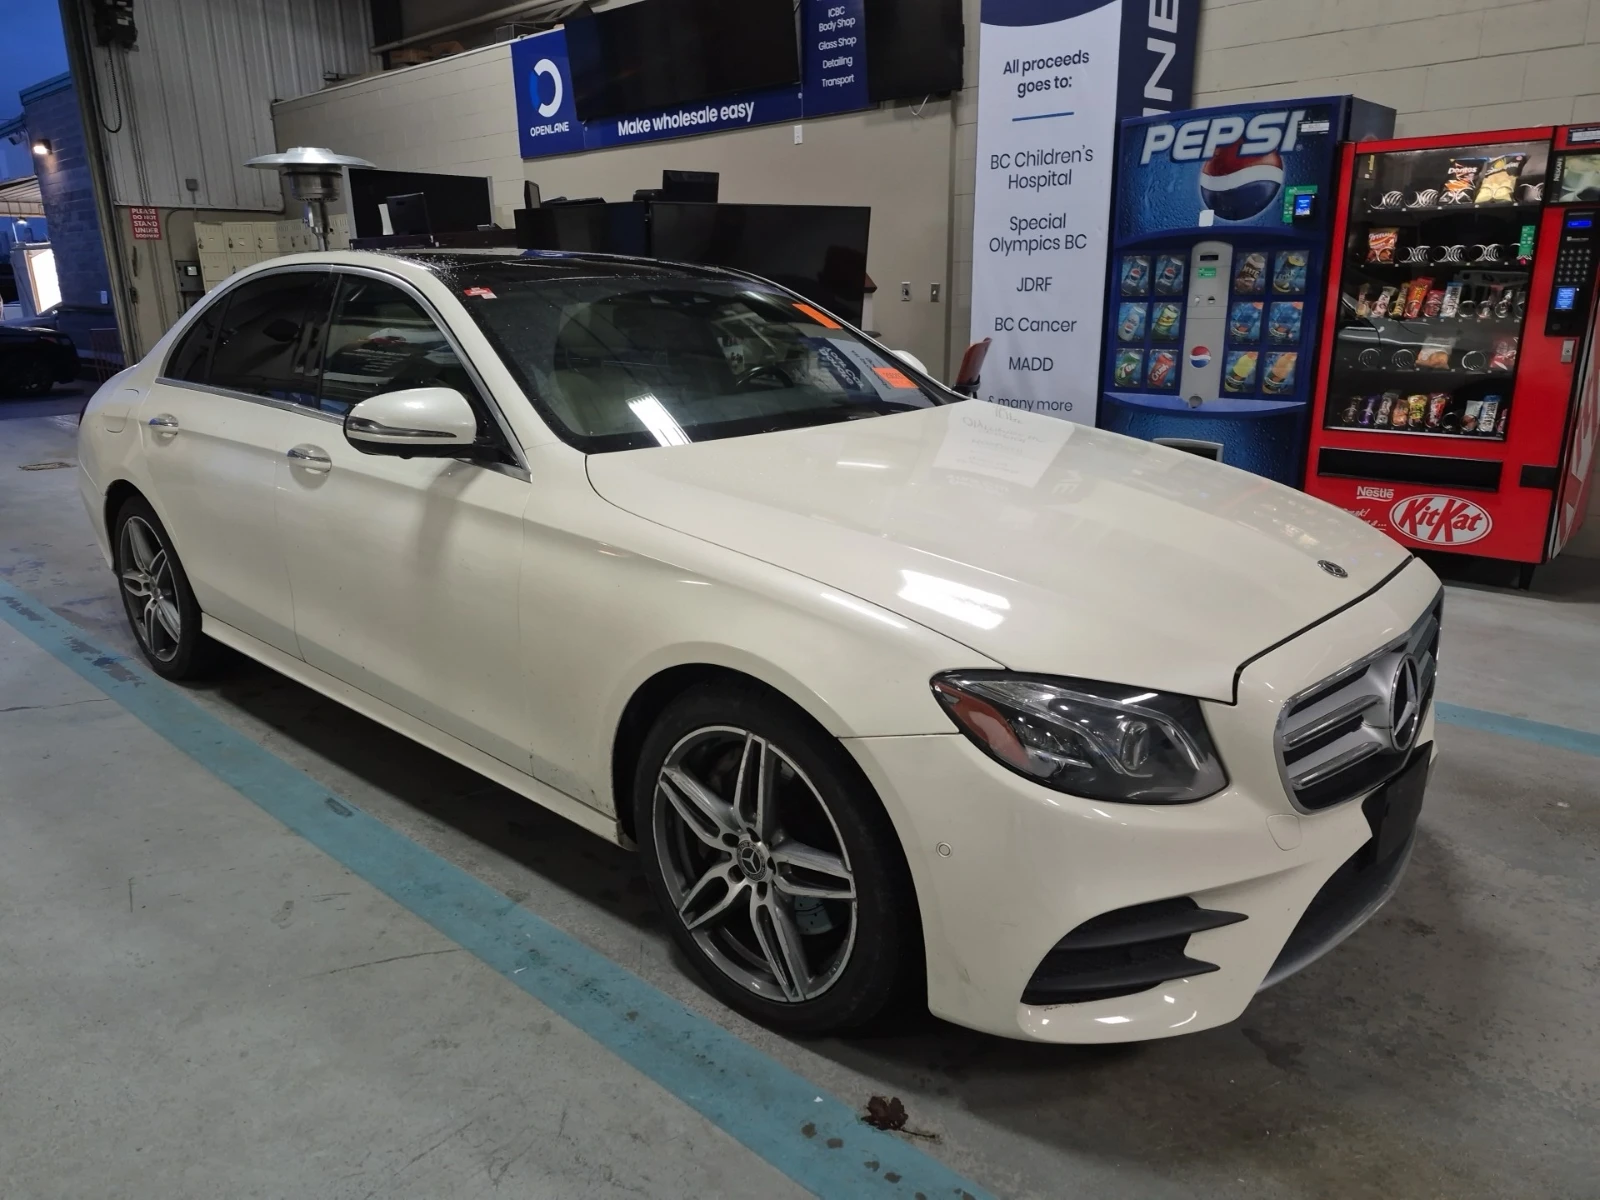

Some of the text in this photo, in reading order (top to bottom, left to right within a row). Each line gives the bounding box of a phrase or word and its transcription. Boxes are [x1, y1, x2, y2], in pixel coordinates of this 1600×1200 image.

[828, 6, 845, 18] ICBC
[819, 18, 855, 32] Body Shop
[818, 37, 857, 50] Glass Shop
[823, 56, 853, 68] Detailing
[1003, 50, 1090, 76] All proceeds
[822, 74, 854, 87] Transport
[1017, 76, 1072, 98] goes to:
[618, 102, 754, 136] Make wholesale easy
[530, 122, 569, 137] OPENLANE
[1140, 110, 1307, 165] PEPSI
[991, 154, 1010, 169] BC
[1448, 166, 1477, 175] Doritos
[1008, 169, 1072, 193] Hospital
[1010, 213, 1066, 235] Special
[989, 234, 1086, 256] Olympics BC
[1017, 277, 1052, 291] JDRF
[995, 317, 1077, 332] BC Cancer
[1009, 357, 1053, 371] MADD
[998, 398, 1034, 412] many
[1037, 400, 1073, 411] more
